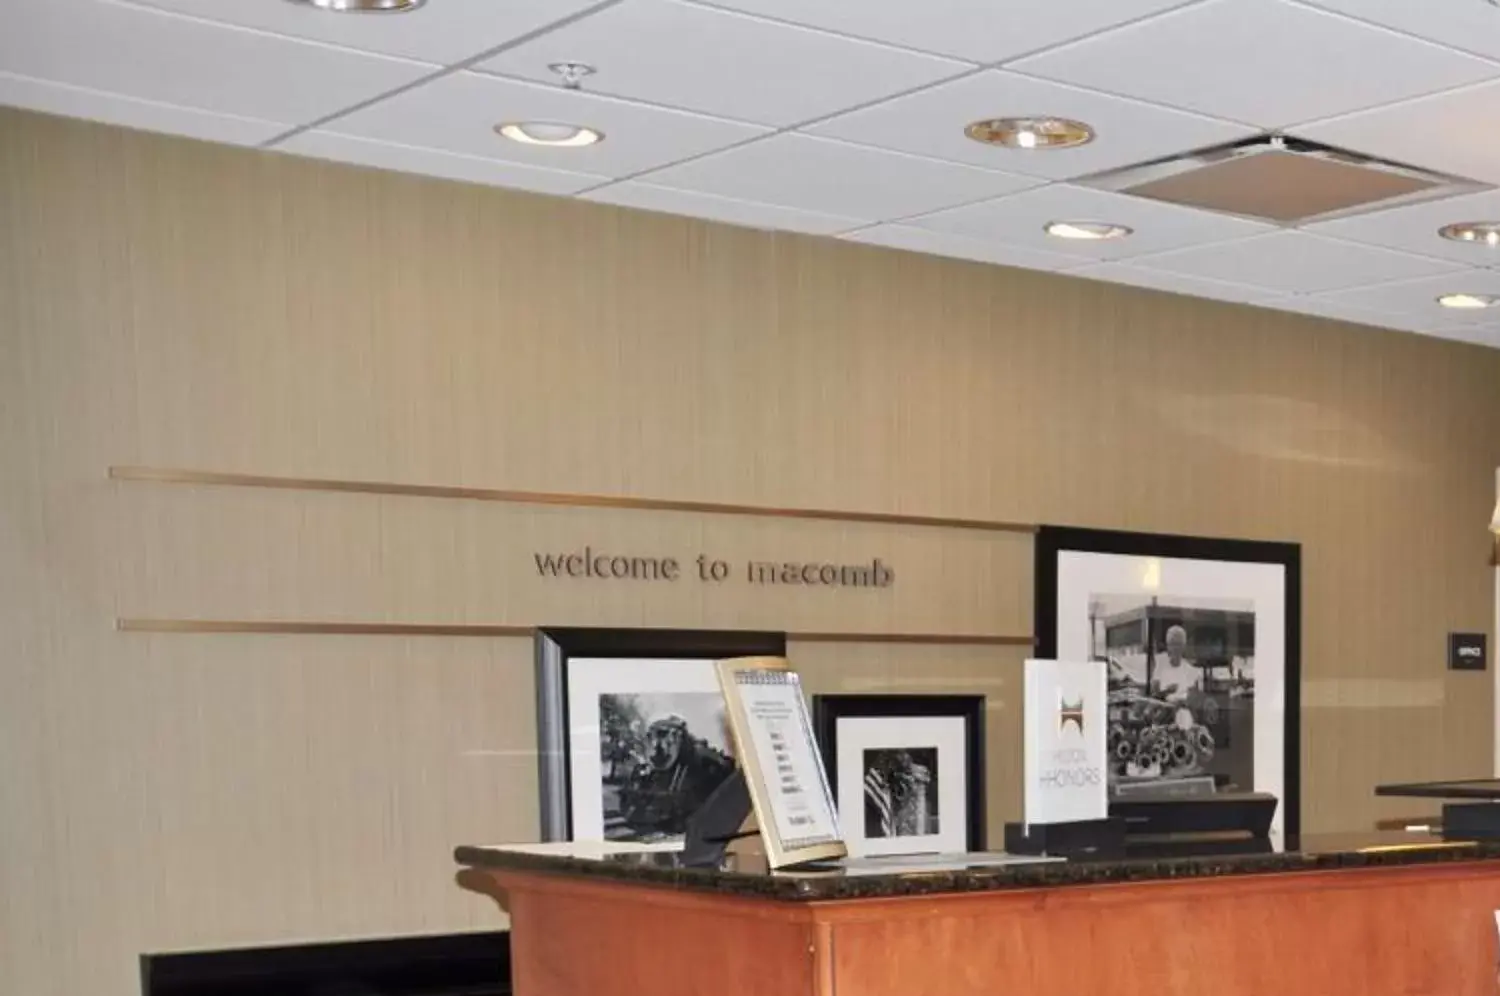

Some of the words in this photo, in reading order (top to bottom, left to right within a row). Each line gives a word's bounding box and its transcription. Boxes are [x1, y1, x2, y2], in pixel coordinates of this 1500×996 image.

[534, 546, 680, 582] welcome
[696, 554, 728, 582] to
[746, 558, 895, 588] macomb
